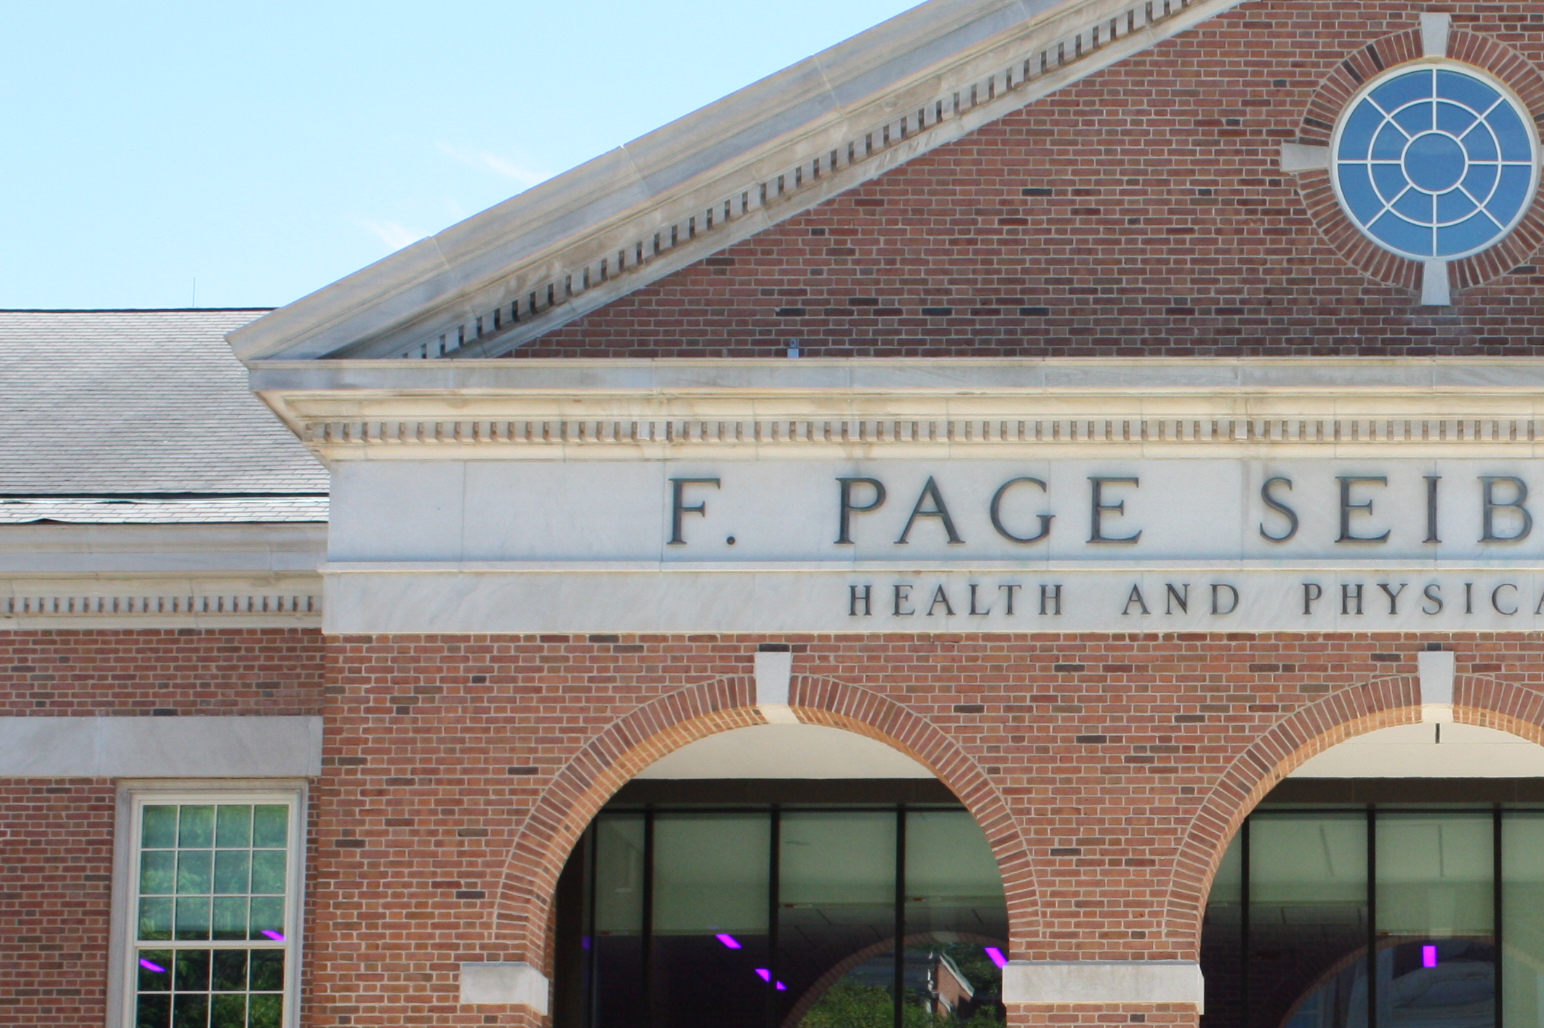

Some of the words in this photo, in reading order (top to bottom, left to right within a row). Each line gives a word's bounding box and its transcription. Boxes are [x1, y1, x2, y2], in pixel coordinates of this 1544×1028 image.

[666, 477, 736, 546] F.
[832, 475, 1143, 545] PAGE
[848, 583, 1065, 617] HEALTH
[1121, 582, 1241, 616] AND
